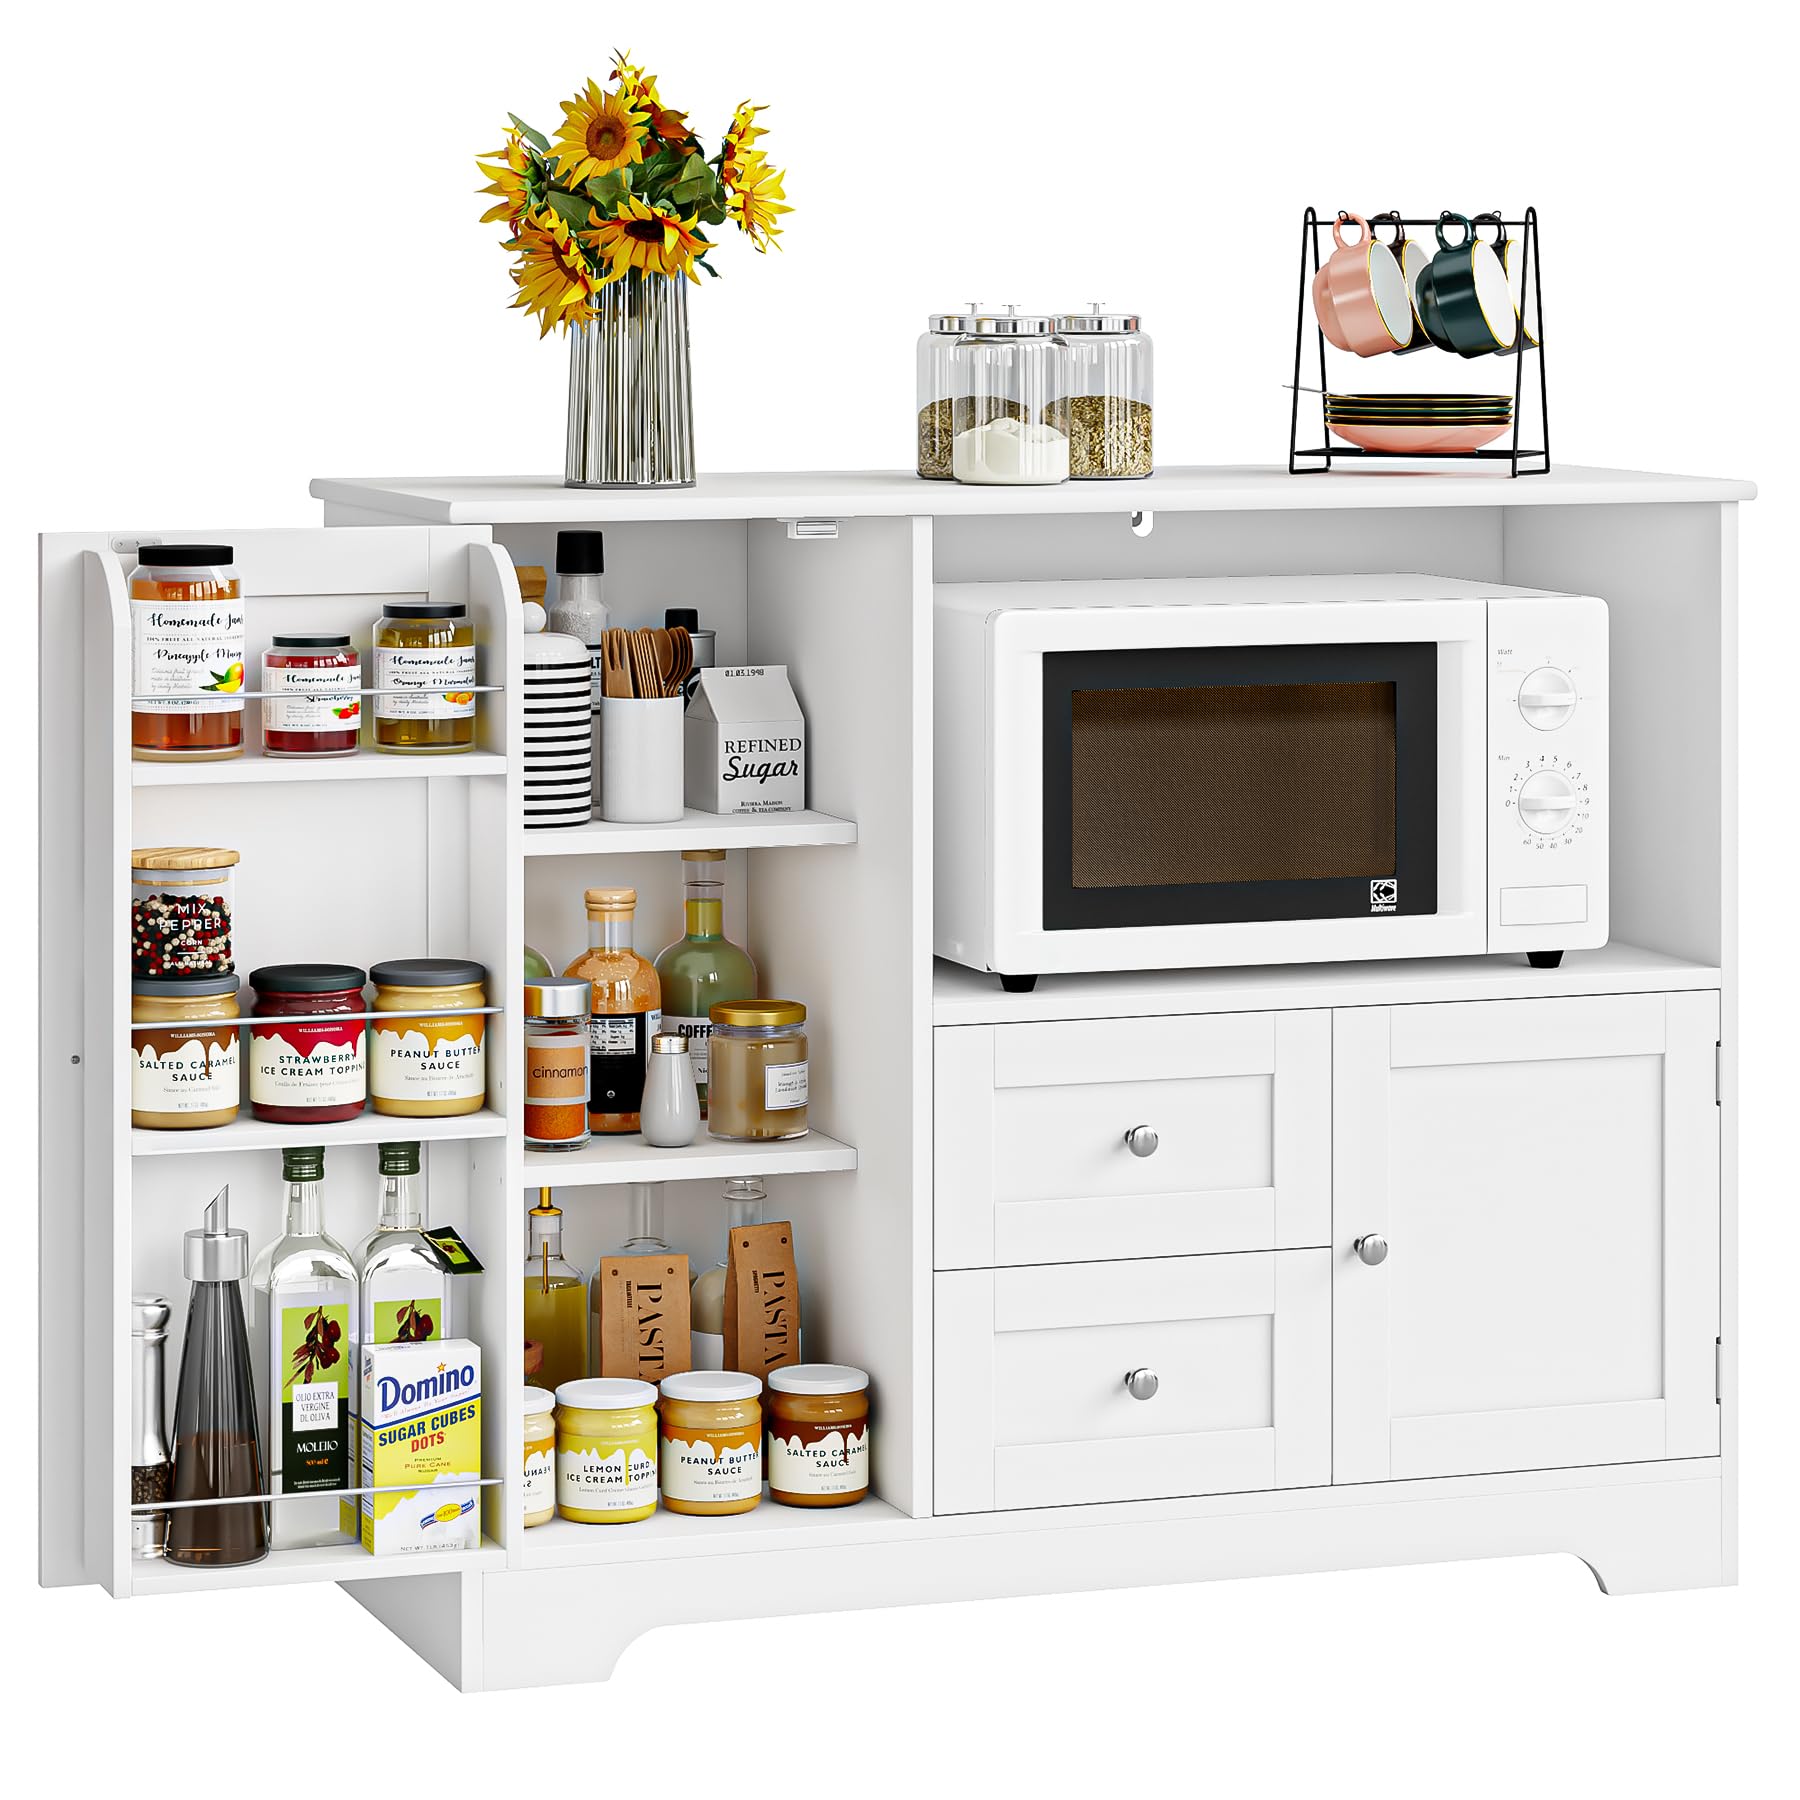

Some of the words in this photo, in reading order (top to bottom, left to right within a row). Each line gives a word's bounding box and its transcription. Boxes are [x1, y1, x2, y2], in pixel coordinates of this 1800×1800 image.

[147, 612, 222, 628] Homemade
[153, 648, 209, 664] Pineapple
[389, 656, 454, 666] Homemade
[724, 738, 802, 754] REFINED
[723, 755, 799, 784] Sugar
[1513, 773, 1518, 781] 2
[1576, 772, 1581, 780] 7
[1505, 799, 1511, 807] 0
[175, 903, 207, 914] MIX
[159, 918, 222, 931] PEPPER
[279, 1053, 355, 1064] STRAWBERRY
[390, 1049, 439, 1059] PEANUT
[139, 1060, 184, 1070] SALTED
[190, 1056, 236, 1069] CARAMEL
[420, 1060, 460, 1070] SAUCE
[260, 1066, 276, 1075] ICE
[281, 1067, 323, 1076] CREAM
[329, 1062, 365, 1075] TOPPIN
[532, 1065, 589, 1079] cinnamon
[171, 1072, 213, 1082] SAUCE
[762, 1271, 788, 1365] PASTA
[377, 1362, 475, 1413] Domino
[295, 1392, 312, 1402] OLIO
[312, 1391, 335, 1400] EXTRA
[300, 1401, 330, 1412] VERGINE
[310, 1412, 331, 1422] OLIVA
[378, 1421, 426, 1447] SUGAR
[430, 1404, 476, 1431] CUBES
[411, 1431, 445, 1453] DOTS
[787, 1448, 826, 1458] SALTED
[831, 1444, 868, 1457] CARAMEL
[680, 1455, 724, 1465] PEANUT
[816, 1459, 850, 1468] SAUCE
[583, 1465, 621, 1473] LEMON
[707, 1466, 742, 1476] SAUCE
[566, 1473, 580, 1482] ICE
[585, 1475, 623, 1484] CREAM
